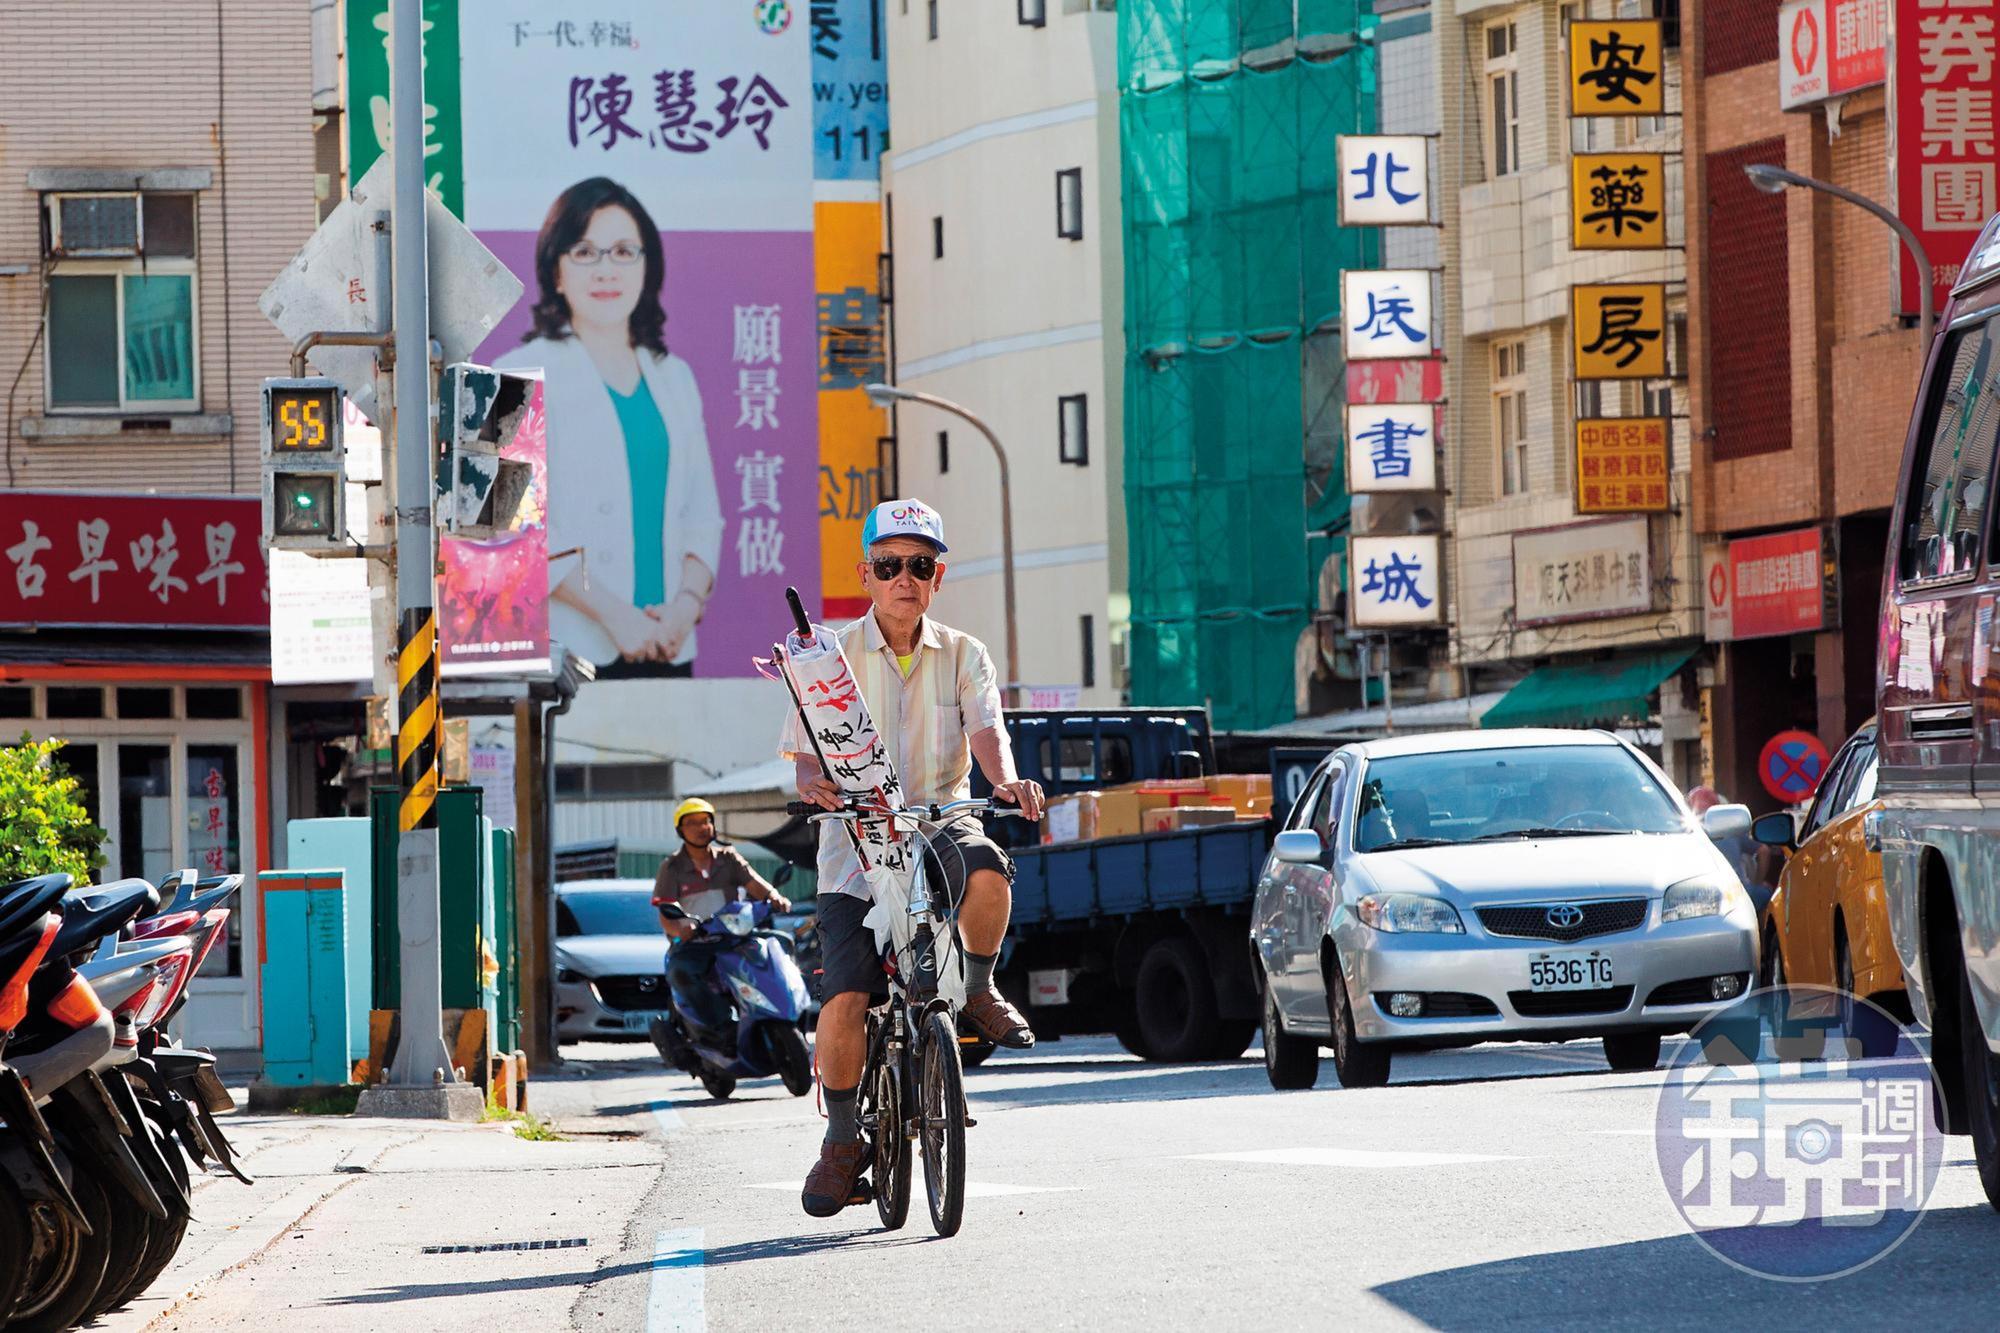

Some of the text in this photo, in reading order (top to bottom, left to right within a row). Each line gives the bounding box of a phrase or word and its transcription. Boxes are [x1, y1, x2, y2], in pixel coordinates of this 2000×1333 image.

[568, 69, 790, 153] 陳慧玲
[1918, 0, 1996, 231] 券集團
[281, 400, 324, 445] 55
[891, 506, 930, 520] ONE
[5, 517, 269, 606] 古早味早
